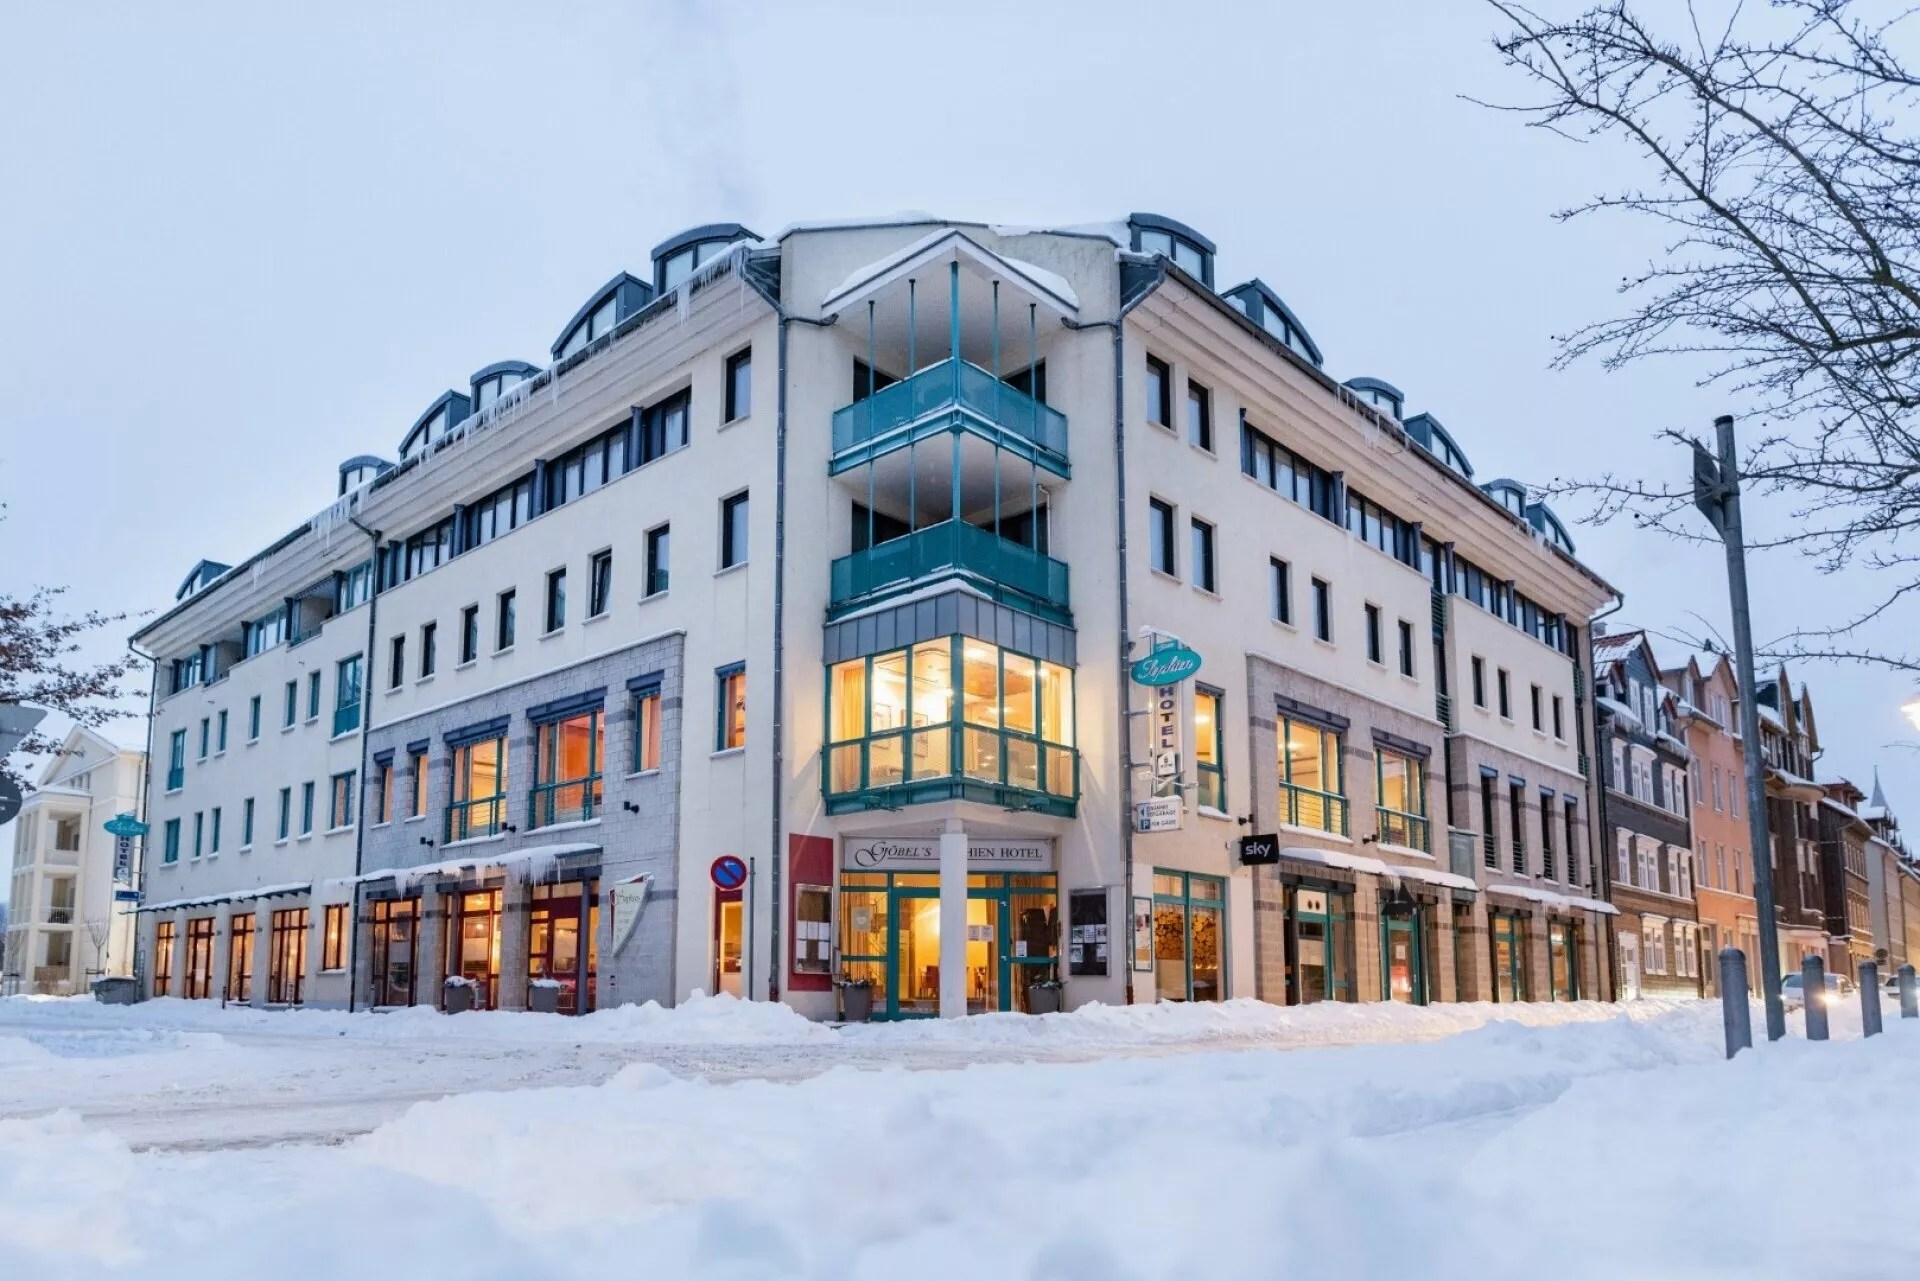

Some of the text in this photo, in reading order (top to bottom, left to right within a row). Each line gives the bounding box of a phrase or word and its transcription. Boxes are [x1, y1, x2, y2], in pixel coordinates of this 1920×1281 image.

[1159, 686, 1174, 748] HOTEL
[120, 835, 130, 867] HOTEL
[967, 847, 995, 858] HIEN
[1001, 847, 1043, 858] HOTEL
[1245, 841, 1271, 857] sky
